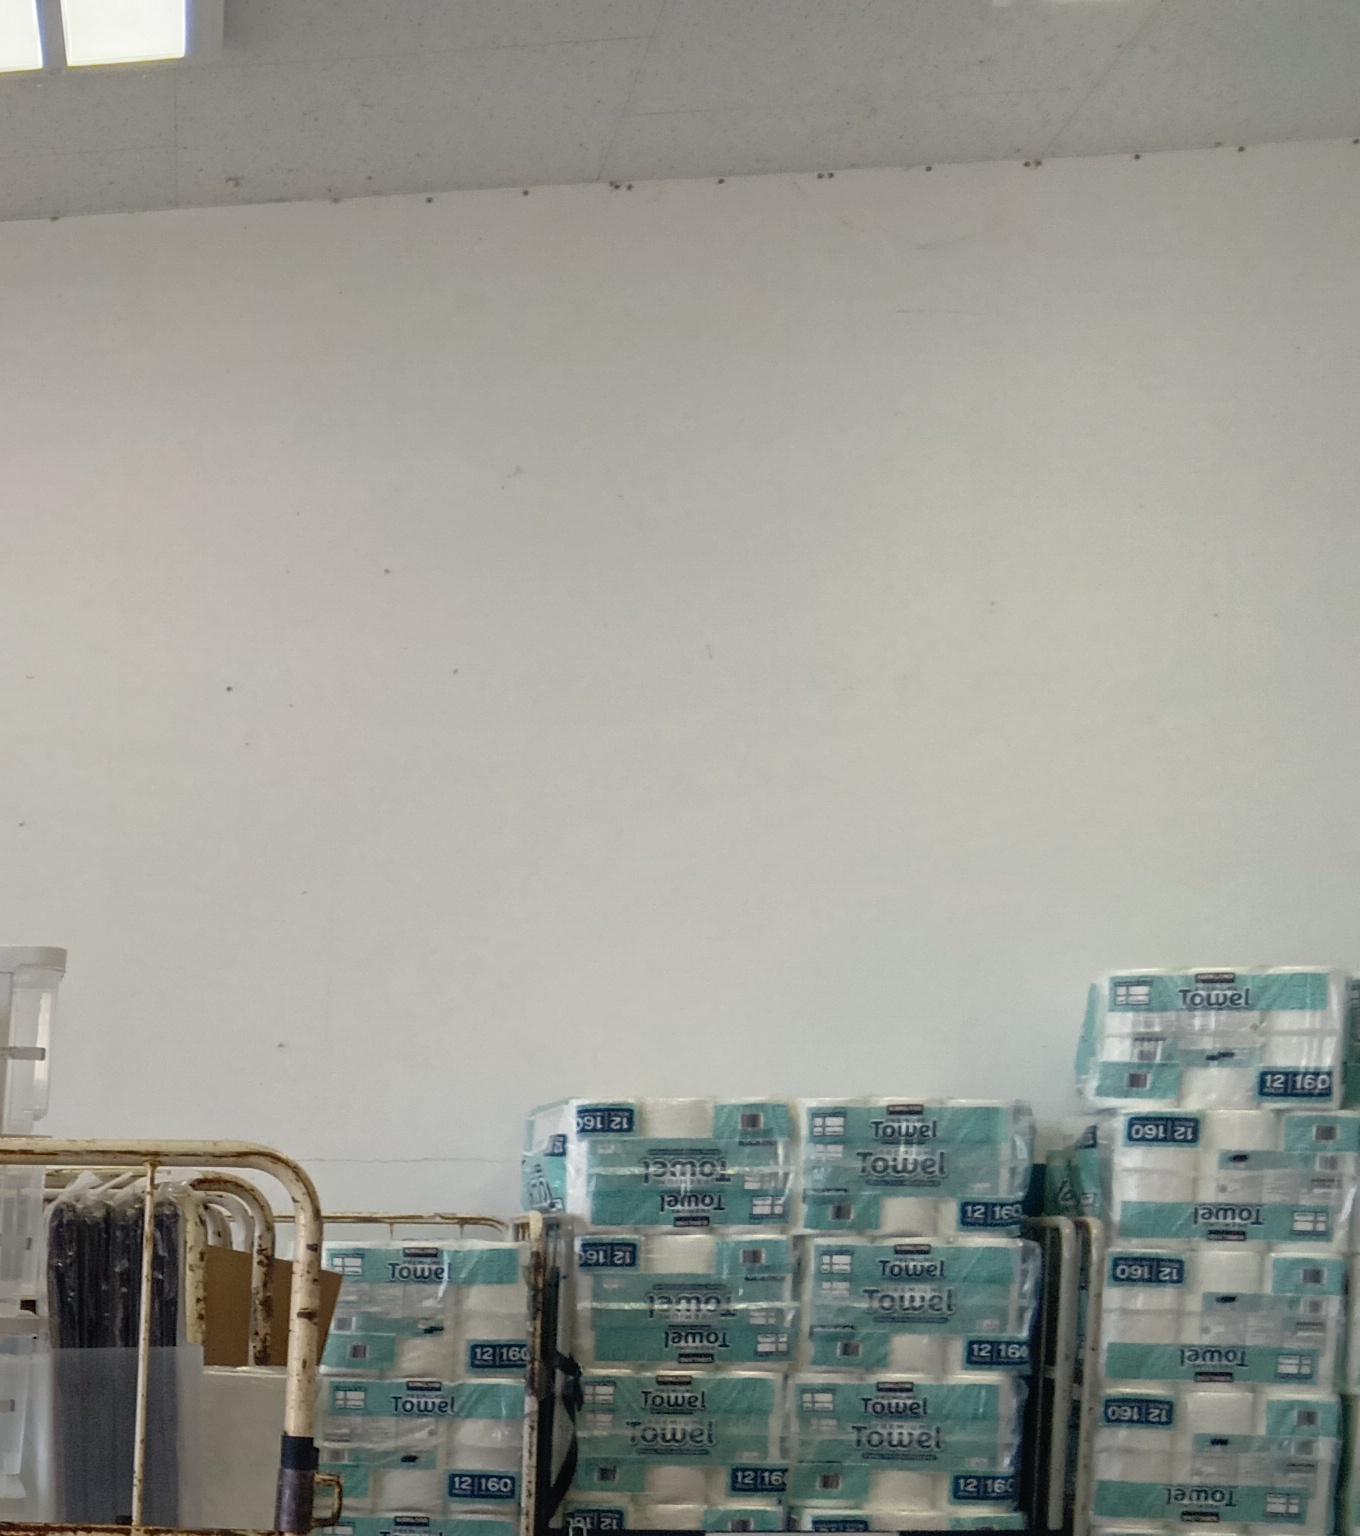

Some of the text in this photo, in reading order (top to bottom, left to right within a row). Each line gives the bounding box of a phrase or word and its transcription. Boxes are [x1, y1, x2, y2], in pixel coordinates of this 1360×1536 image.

[1179, 988, 1251, 1007] Towel
[1265, 1075, 1329, 1089] 12 160
[610, 1117, 629, 1129] 12
[870, 1120, 937, 1139] Towel
[1131, 1125, 1194, 1139] 12 160
[856, 1151, 947, 1176] Towel
[659, 1193, 725, 1211] Towel
[965, 1204, 984, 1218] 12
[1193, 1206, 1264, 1225] Towel
[613, 1252, 631, 1264] 12
[387, 1262, 452, 1281] Towel
[878, 1260, 945, 1277] Towel
[1116, 1265, 1178, 1280] 12 160
[862, 1288, 954, 1312] Towel
[664, 1331, 730, 1348] Towel
[473, 1348, 493, 1360] 12
[971, 1343, 991, 1356] 12
[1180, 1349, 1249, 1367] Towel
[392, 1396, 456, 1413] Towel
[641, 1391, 706, 1409] Towel
[861, 1397, 928, 1415] Towel
[1107, 1406, 1169, 1421] 12 160
[627, 1421, 716, 1445] Towel
[851, 1425, 942, 1449] Towel
[453, 1476, 513, 1492] 12 160
[735, 1470, 754, 1483] 12
[958, 1478, 978, 1491] 12
[1167, 1487, 1237, 1507] Towel
